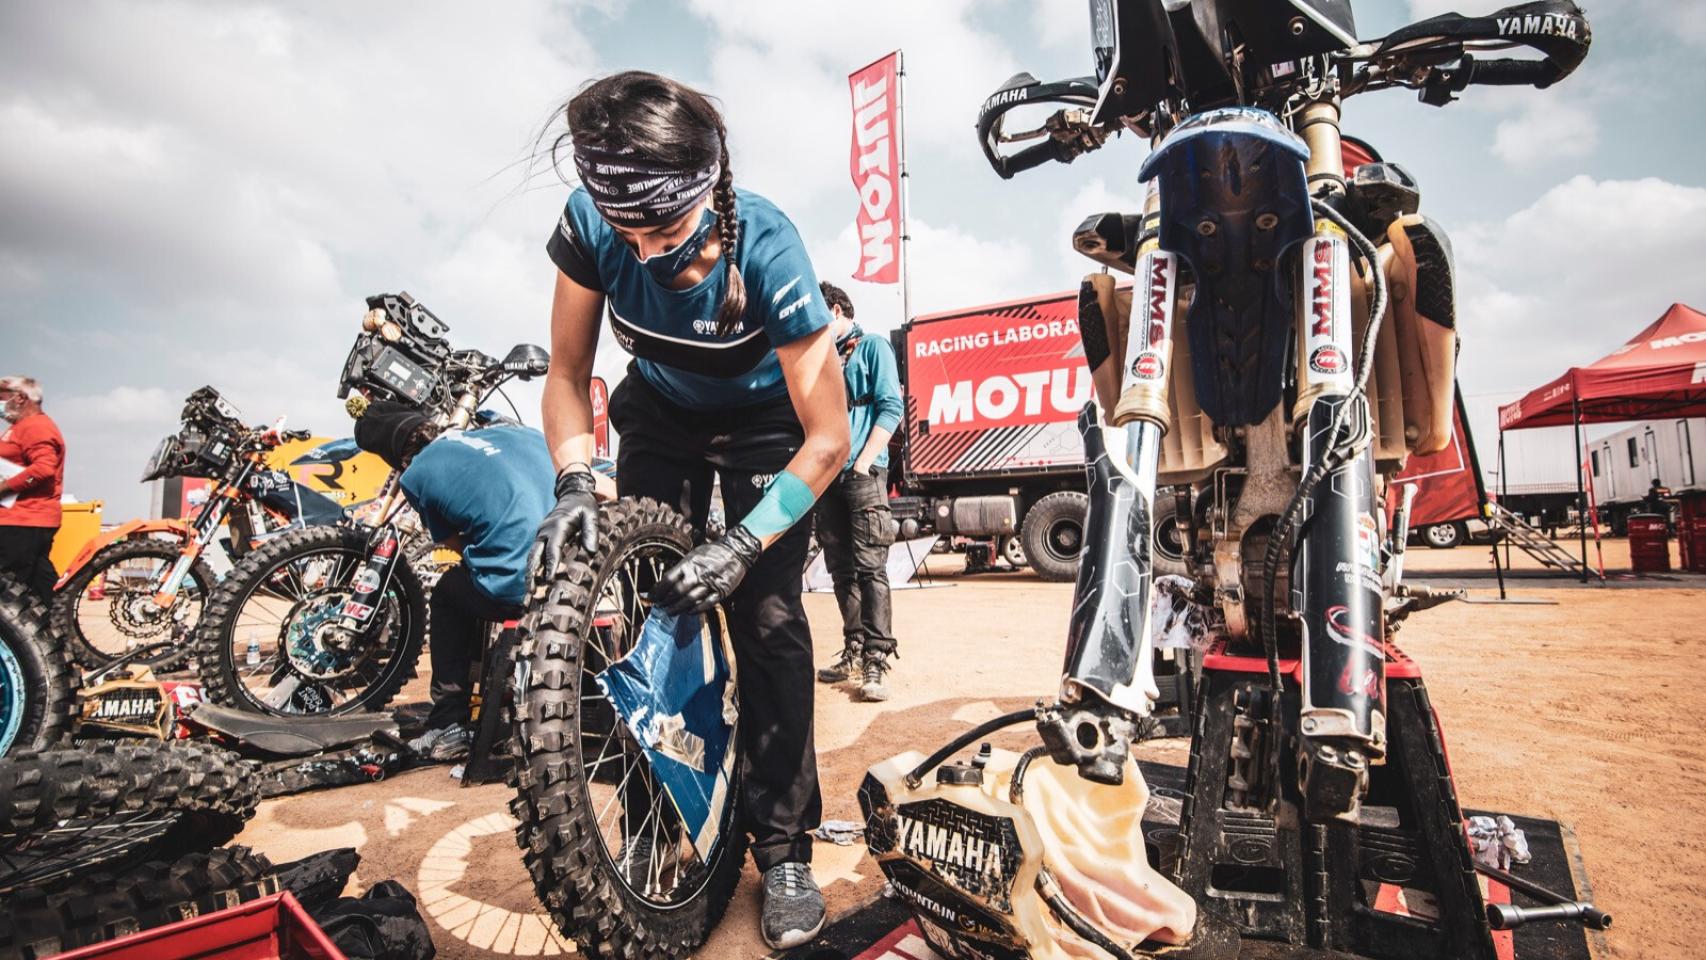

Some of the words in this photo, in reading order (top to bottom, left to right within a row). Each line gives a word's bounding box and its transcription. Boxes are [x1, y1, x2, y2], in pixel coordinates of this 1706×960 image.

[1497, 16, 1577, 39] YAMAHA
[979, 87, 1028, 117] YAMAHA
[1149, 257, 1168, 347] MMS
[1311, 240, 1332, 337] MMS
[915, 333, 989, 357] RACING
[993, 319, 1080, 344] LABORA
[1650, 331, 1706, 350] MO
[928, 366, 1094, 426] MOTU
[91, 698, 155, 717] AMAHA
[898, 815, 1002, 878] YAMAHA
[891, 879, 956, 922] MOUNTAIN
